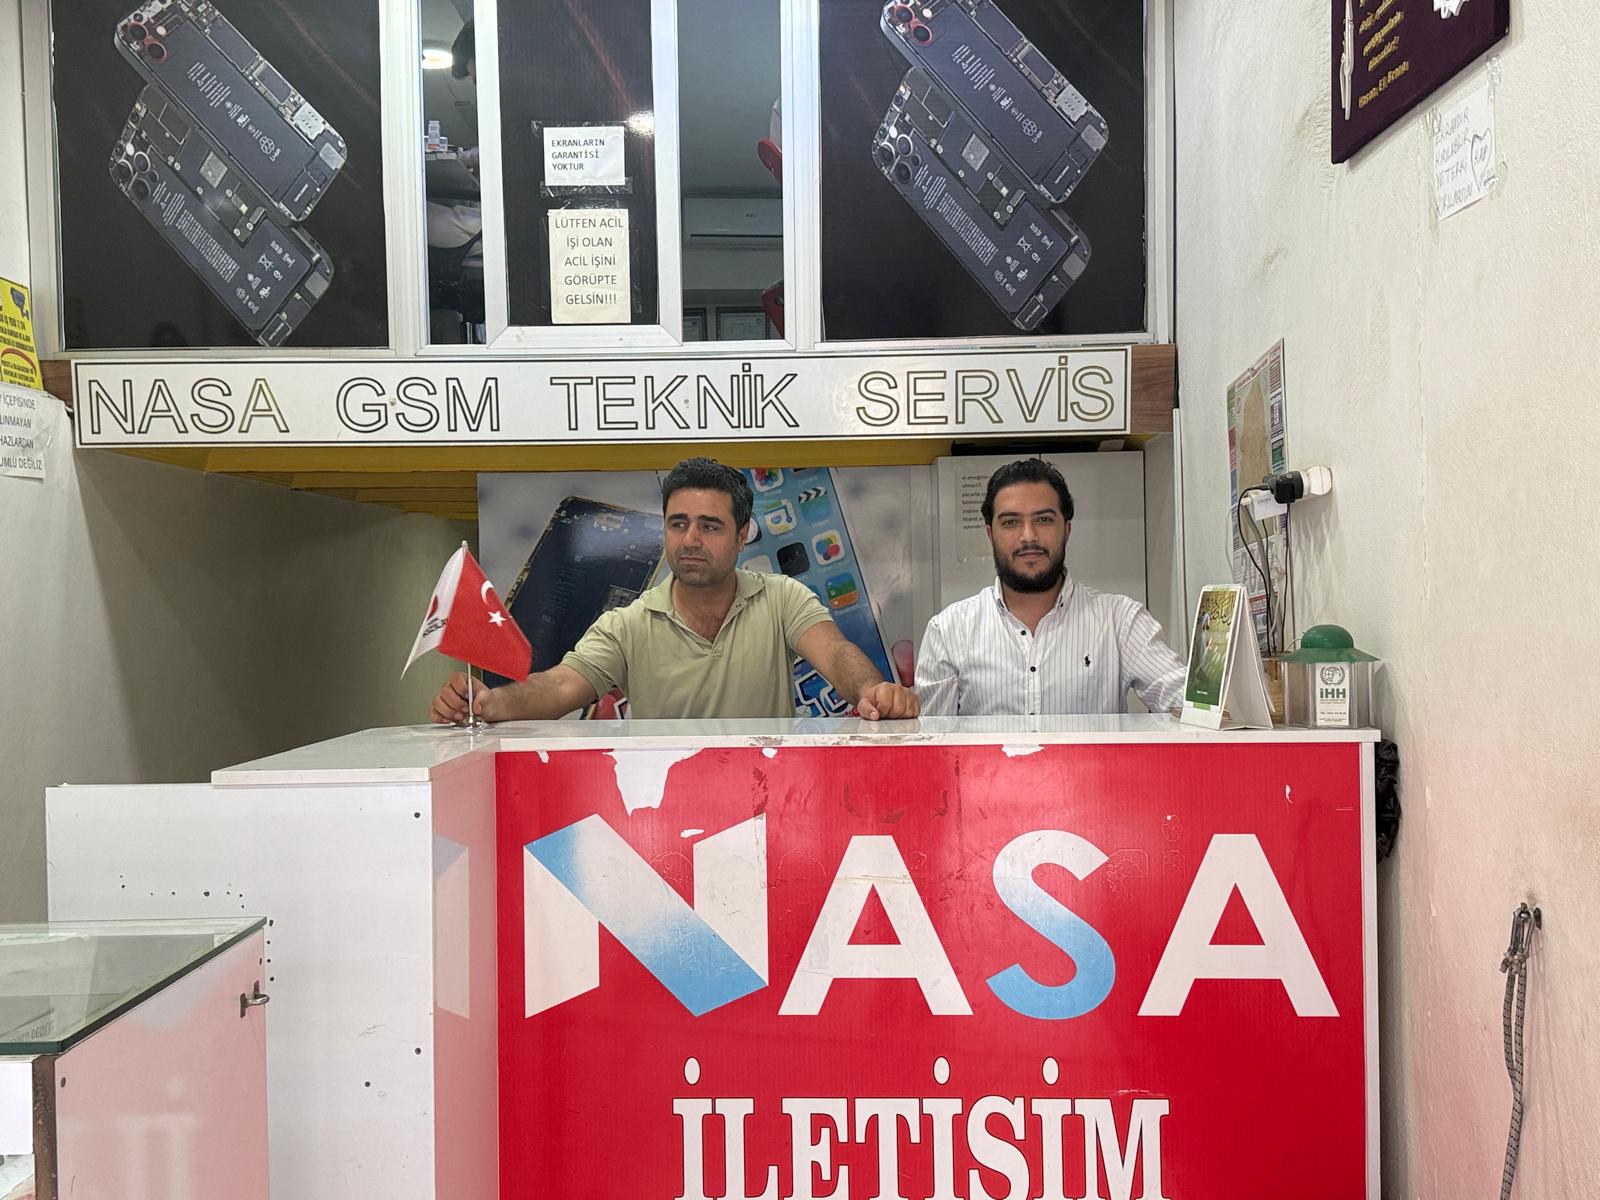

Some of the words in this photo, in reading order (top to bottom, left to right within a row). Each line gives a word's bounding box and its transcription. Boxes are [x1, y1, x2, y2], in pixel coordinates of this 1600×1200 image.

[551, 138, 605, 148] EKRANLARIN
[551, 148, 600, 160] GARANTİSİ
[552, 162, 585, 171] YOKTUR
[555, 215, 597, 229] LÜTFEN
[600, 216, 624, 228] ACİL
[566, 237, 580, 250] İŞİ
[582, 237, 613, 248] OLAN
[564, 256, 588, 267] ACİL
[591, 255, 616, 269] İŞİNİ
[564, 274, 617, 286] GÖRÜPTE
[565, 293, 617, 305] GELSİN!!!
[88, 377, 290, 435] NASA
[336, 376, 501, 433] GSM
[550, 362, 800, 431] TEKNİK
[856, 355, 1115, 428] SERVİS
[19, 456, 42, 471] DEĞİLİZ
[523, 812, 1341, 1020] NASA
